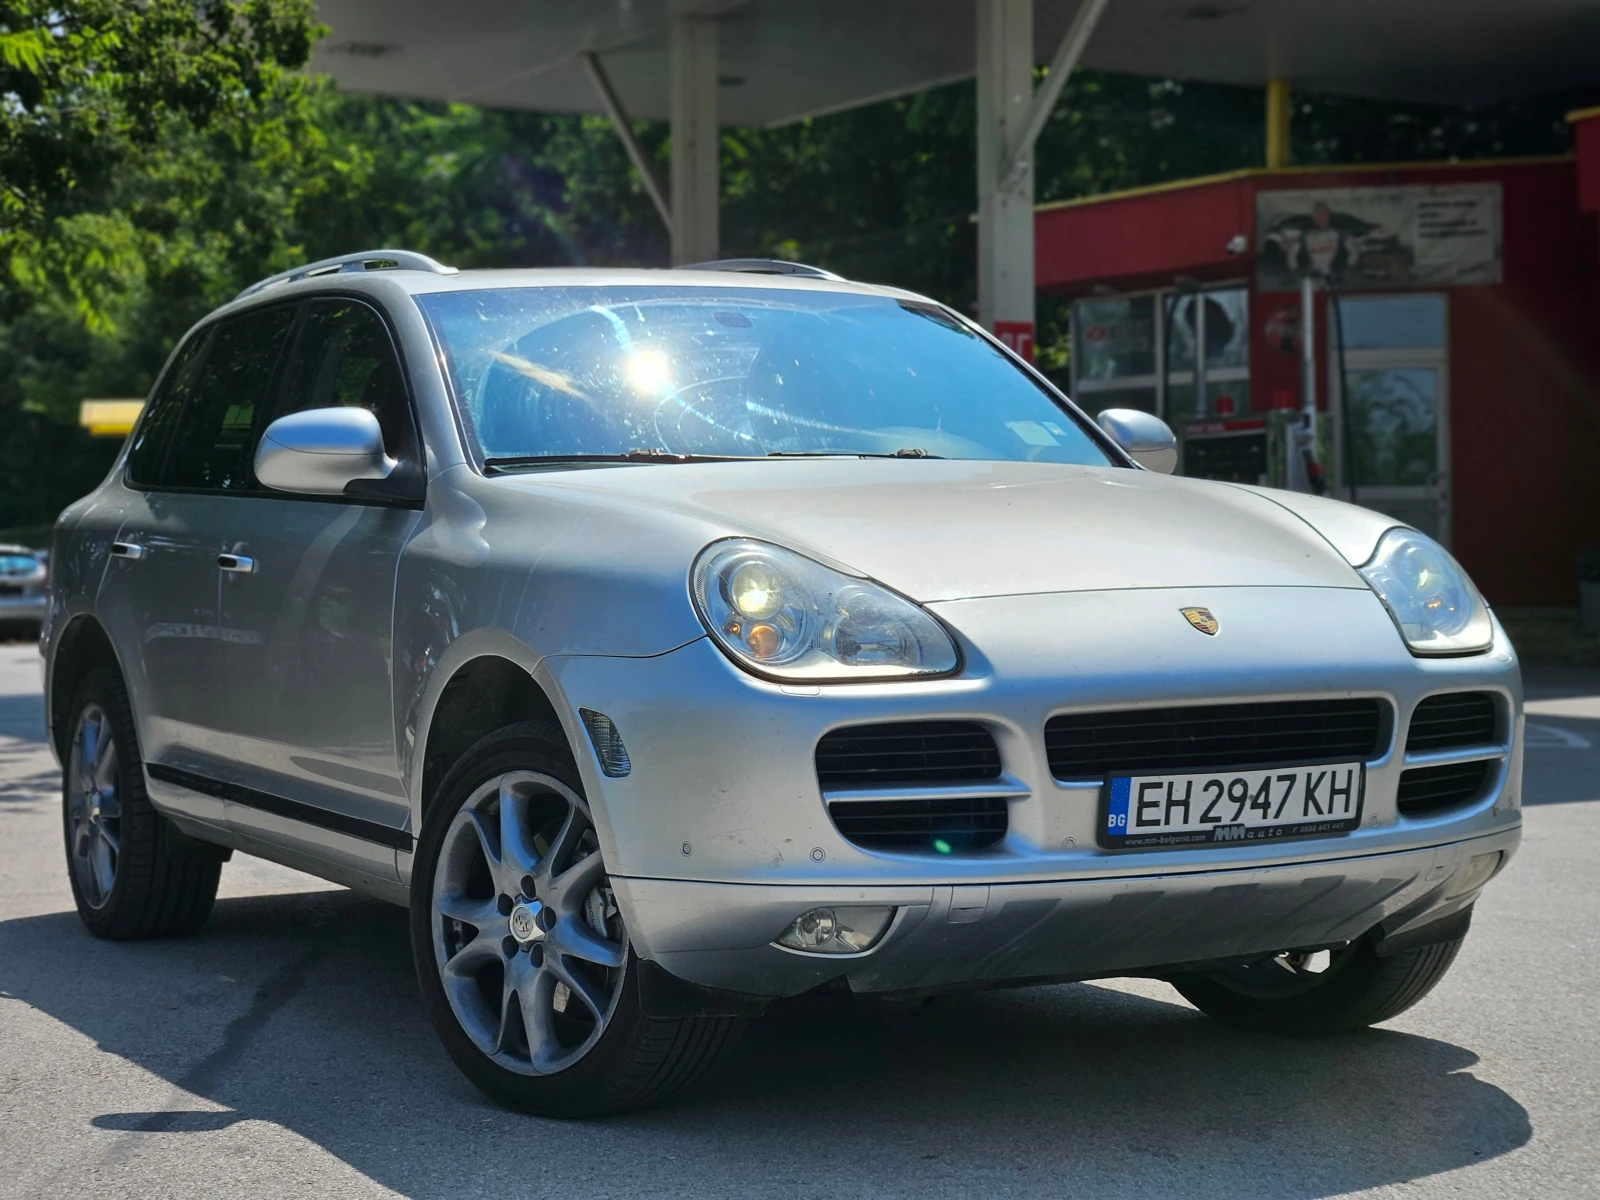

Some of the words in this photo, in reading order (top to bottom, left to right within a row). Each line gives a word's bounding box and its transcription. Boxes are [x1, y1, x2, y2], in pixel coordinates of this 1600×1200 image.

[1135, 780, 1193, 828] EH
[1199, 773, 1297, 824] 2947
[1302, 769, 1354, 817] KH
[1107, 813, 1126, 828] BG
[1213, 824, 1245, 842] MM
[1247, 827, 1283, 839] auto
